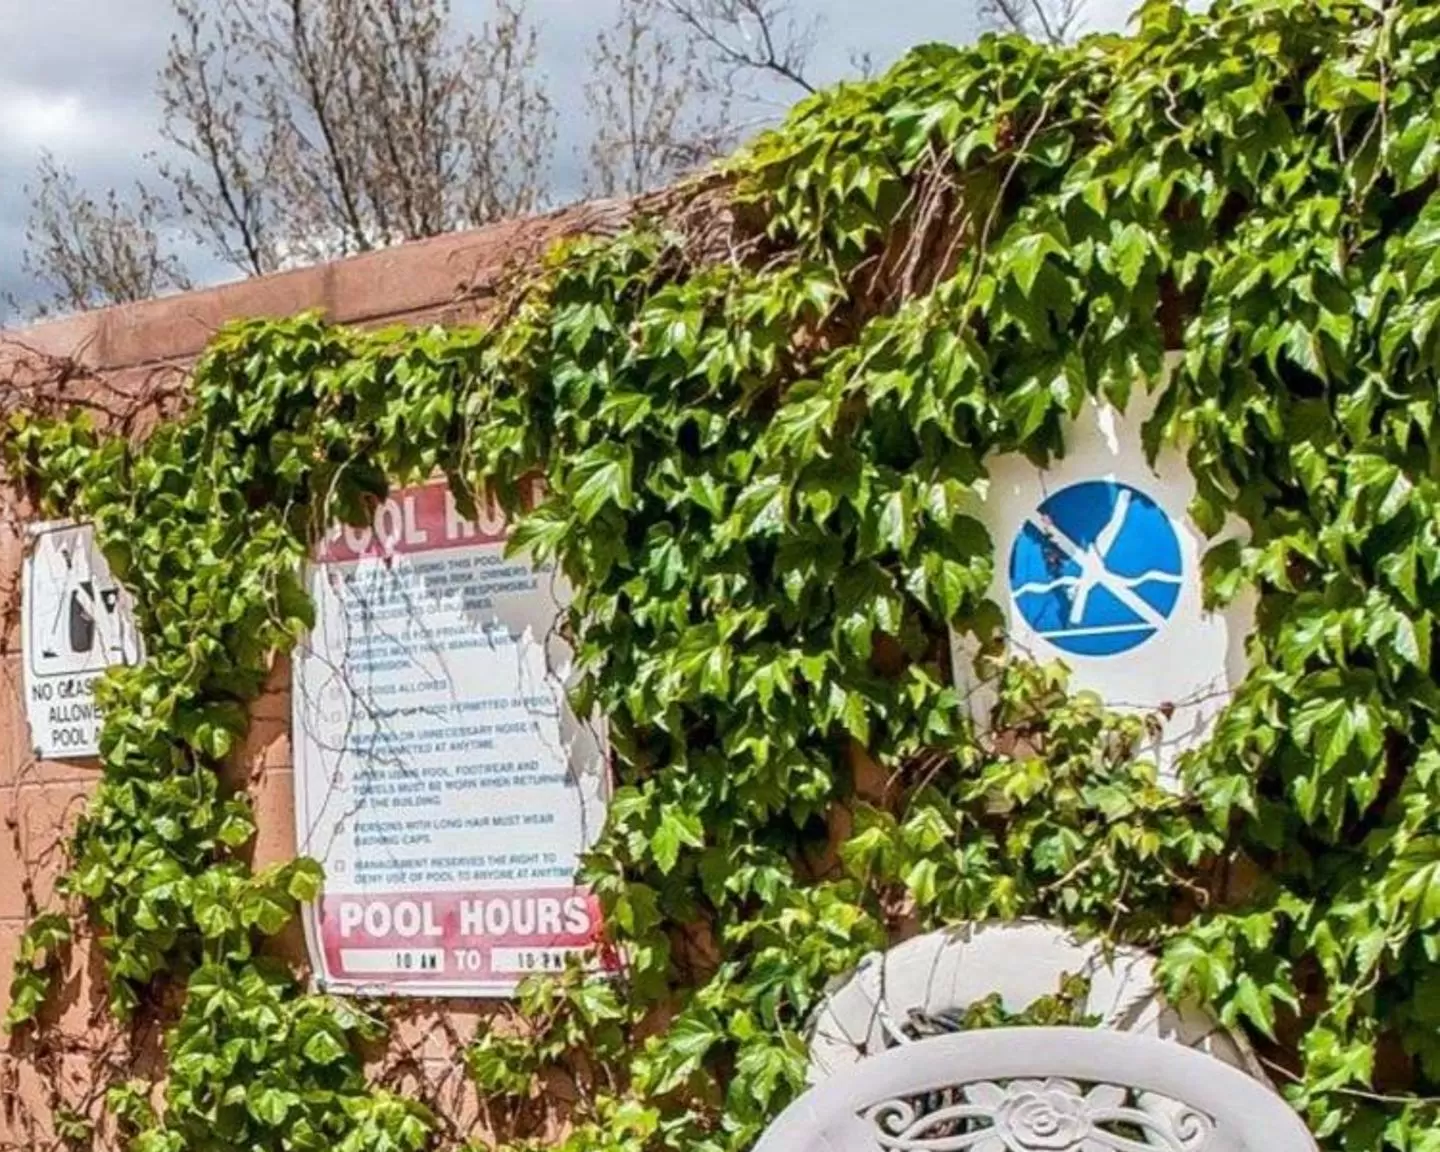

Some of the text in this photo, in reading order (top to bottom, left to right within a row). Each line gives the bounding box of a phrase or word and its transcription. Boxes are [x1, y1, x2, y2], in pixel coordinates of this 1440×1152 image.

[327, 496, 428, 555] OOL
[32, 678, 96, 701] NO GLAS
[50, 703, 103, 722] ALLOWE
[53, 727, 87, 746] POOL
[340, 897, 590, 937] POOL HOURS
[421, 953, 436, 968] AM
[454, 949, 480, 970] TO
